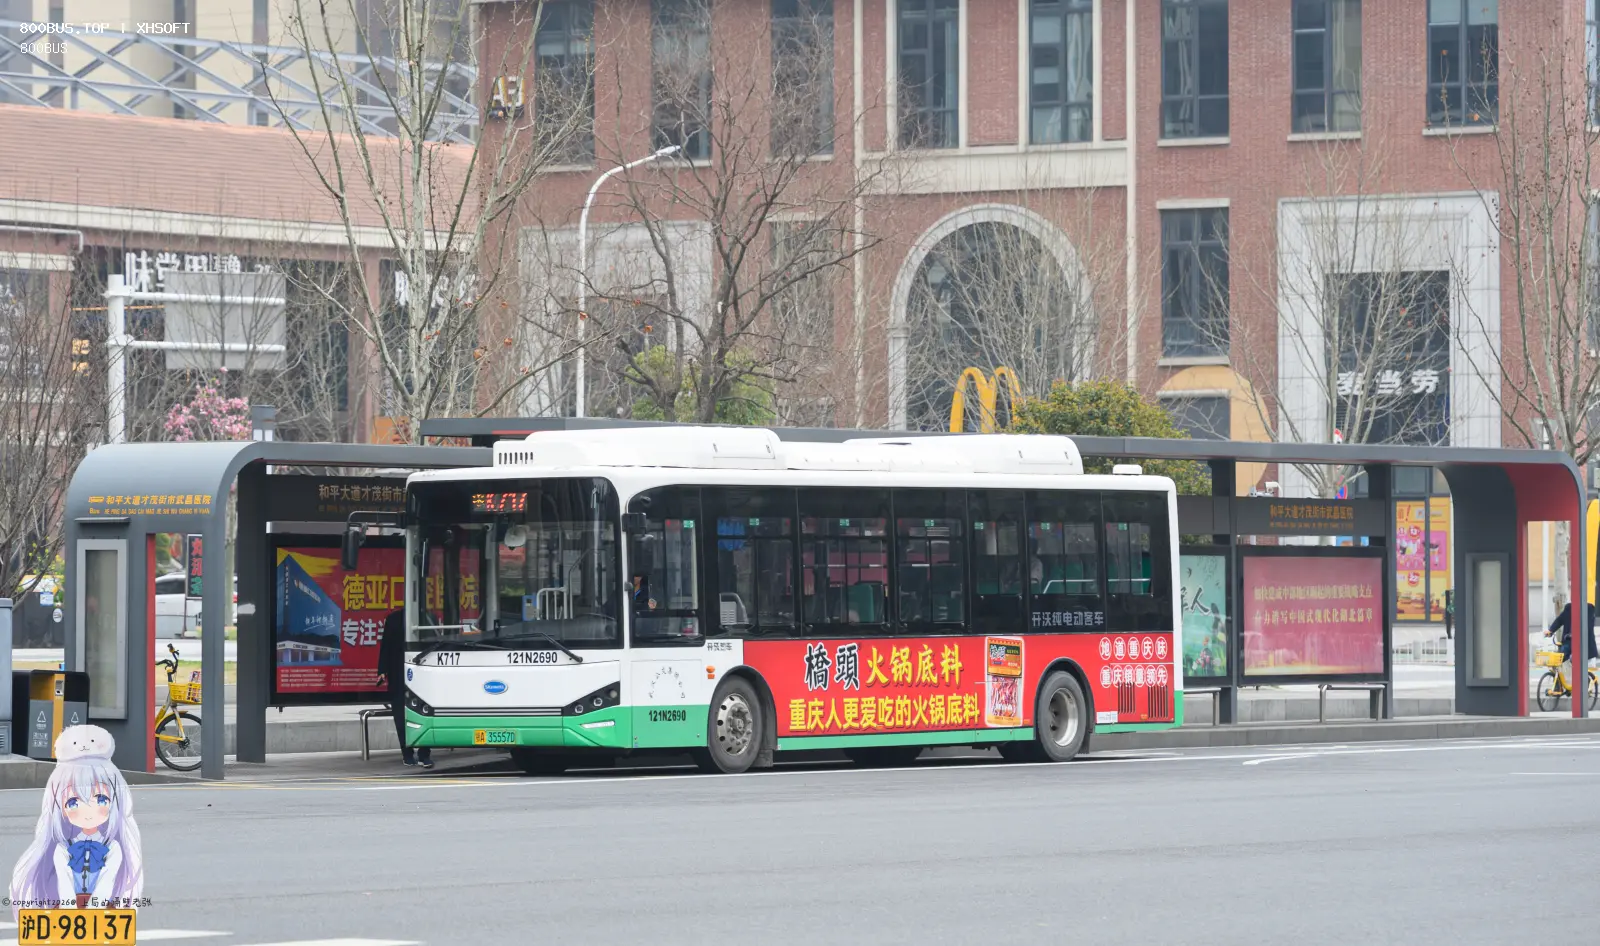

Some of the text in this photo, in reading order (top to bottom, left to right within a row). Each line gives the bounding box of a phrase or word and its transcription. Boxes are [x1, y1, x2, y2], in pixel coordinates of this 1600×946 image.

[1337, 369, 1439, 396] 麦当劳
[105, 494, 212, 505] 和平大道才茂街市武昌医院
[1032, 611, 1104, 627] 开沃纯电动客车
[1100, 639, 1167, 658] 地道重庆味
[437, 652, 461, 666] K717
[507, 651, 558, 664] 121N2690
[865, 644, 963, 687] 火锅底料
[648, 709, 687, 722] 121N2690
[789, 693, 980, 730] 重庆人更爱吃的火锅底料
